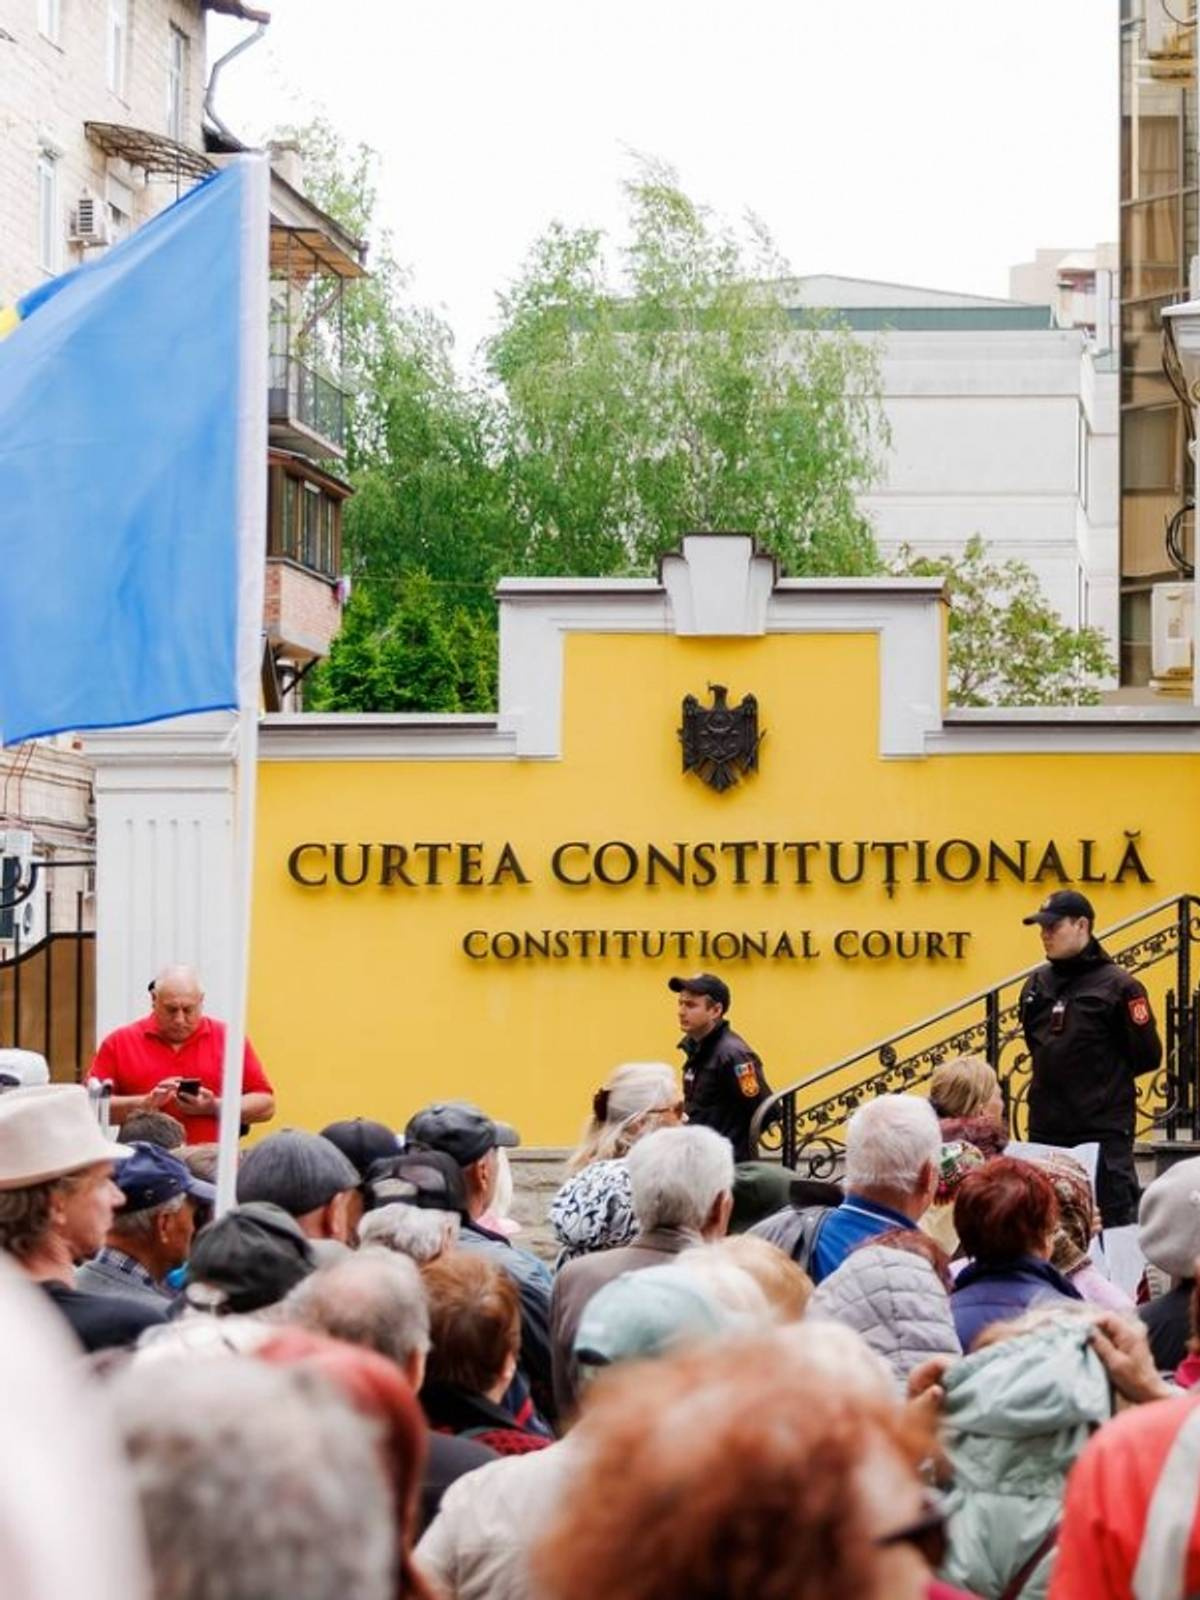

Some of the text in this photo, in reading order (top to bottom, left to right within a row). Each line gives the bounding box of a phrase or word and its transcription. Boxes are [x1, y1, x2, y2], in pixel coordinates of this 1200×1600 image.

[287, 830, 1155, 899] CURTEA CONSTITUȚIONALĂ
[462, 930, 972, 961] CONSTITUTIONAL COURT
